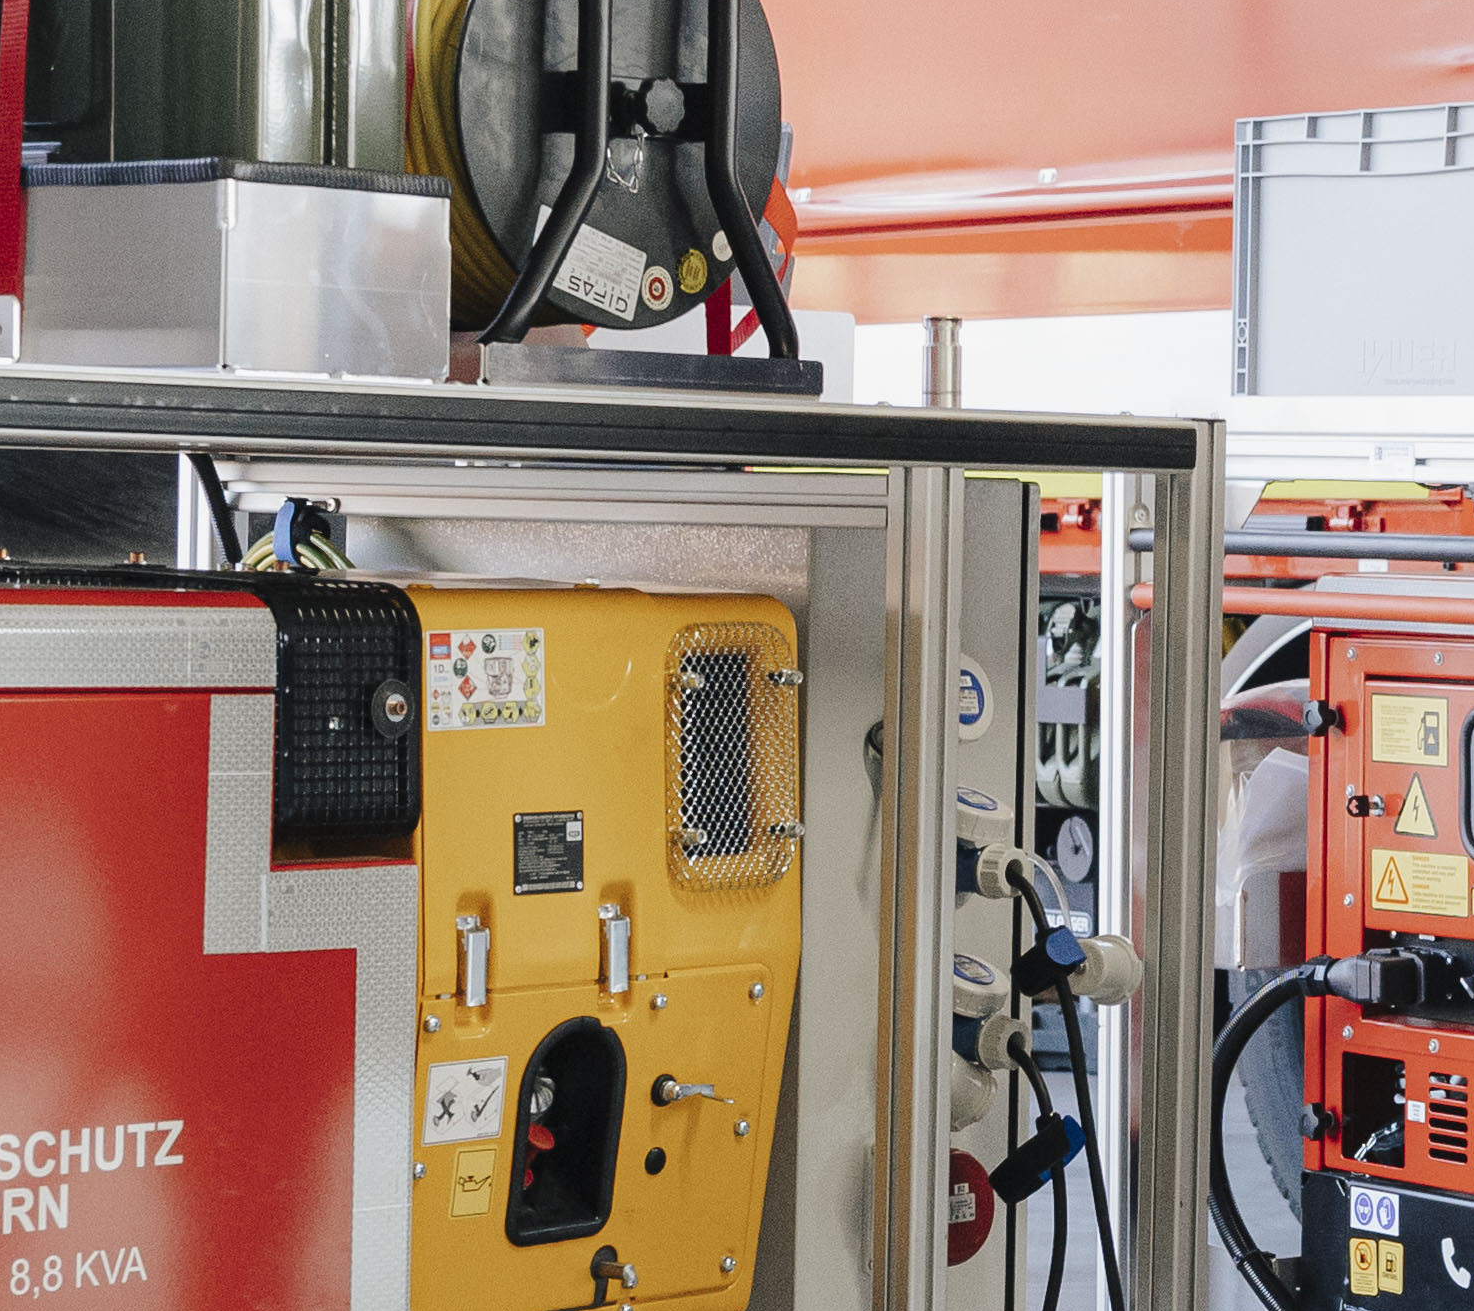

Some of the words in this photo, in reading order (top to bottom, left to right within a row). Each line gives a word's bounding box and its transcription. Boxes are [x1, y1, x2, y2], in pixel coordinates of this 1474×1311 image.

[567, 275, 629, 314] GIFAS
[10, 1253, 63, 1301] 8,8
[74, 1246, 148, 1288] KVA
